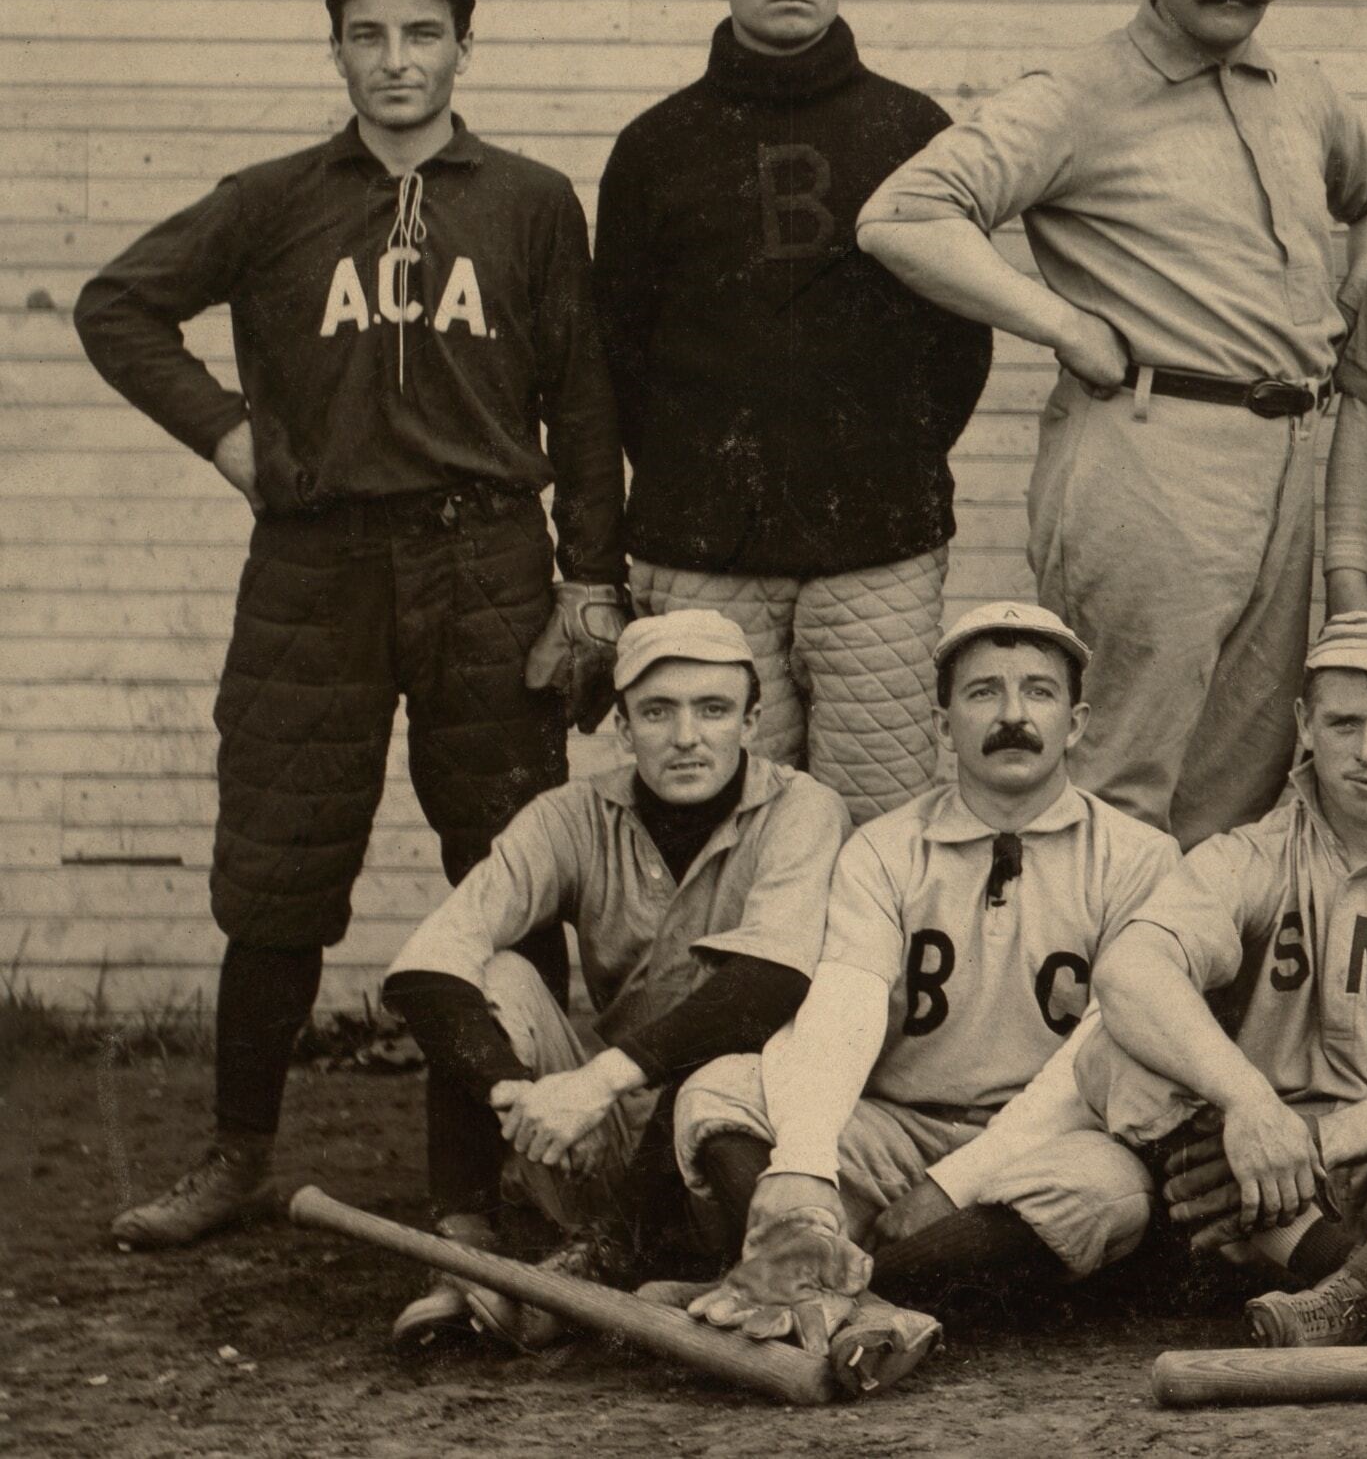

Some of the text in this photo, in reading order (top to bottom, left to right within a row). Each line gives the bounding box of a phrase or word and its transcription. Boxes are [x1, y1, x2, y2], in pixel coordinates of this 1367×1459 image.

[758, 142, 834, 259] B
[902, 928, 1091, 1037] B C
